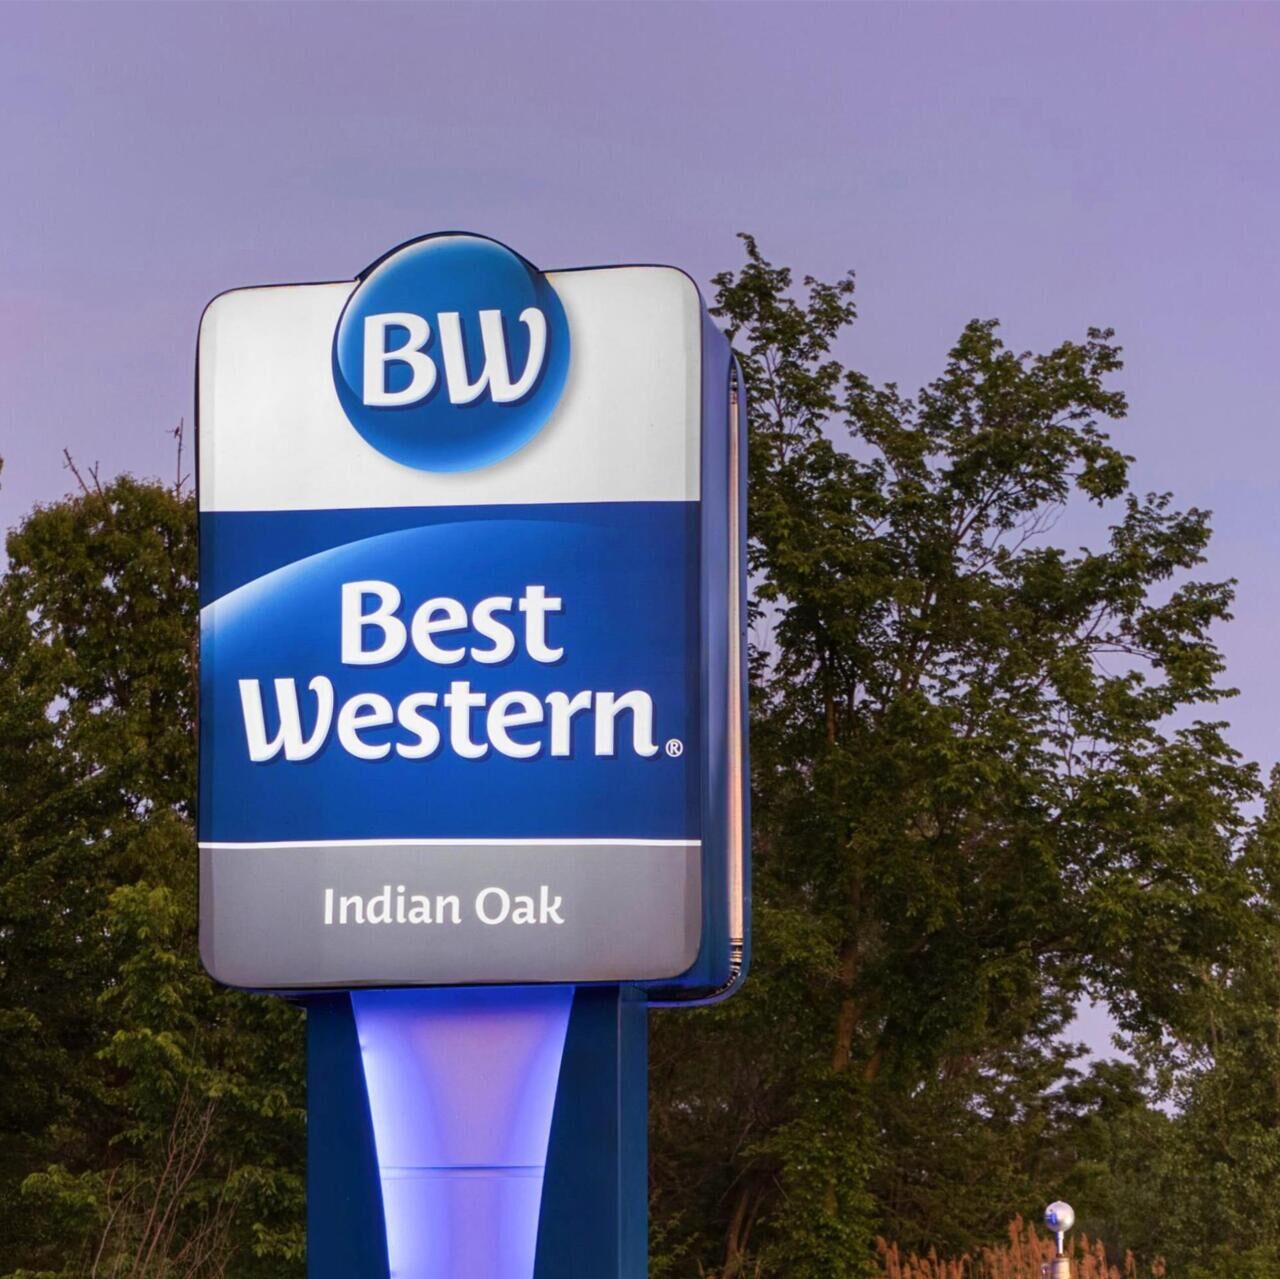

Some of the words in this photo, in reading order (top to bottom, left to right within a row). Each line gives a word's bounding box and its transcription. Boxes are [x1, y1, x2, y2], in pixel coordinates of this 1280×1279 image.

[362, 307, 547, 407] BW
[341, 579, 564, 665] Best
[323, 884, 463, 925] Indian
[474, 884, 566, 926] Oak
